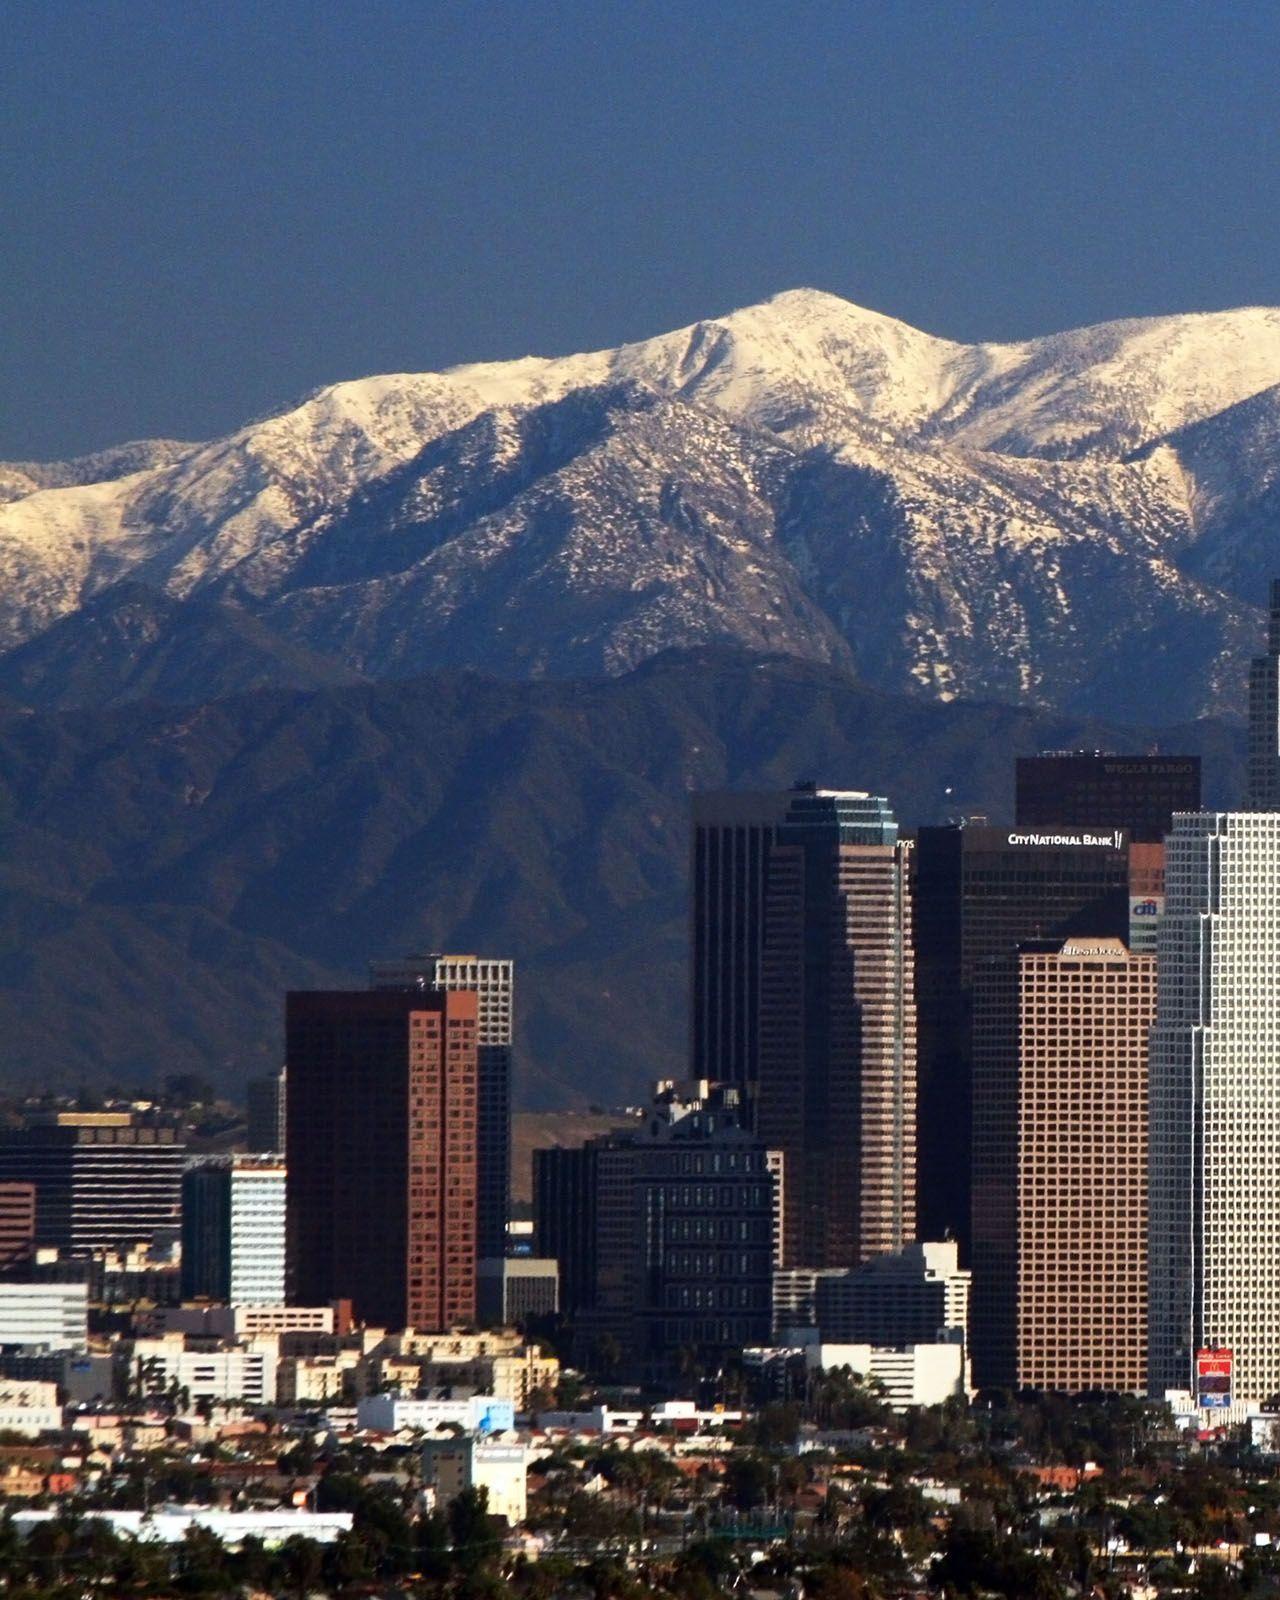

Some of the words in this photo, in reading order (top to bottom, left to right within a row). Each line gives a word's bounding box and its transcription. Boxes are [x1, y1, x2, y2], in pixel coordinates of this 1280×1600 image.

[1151, 763, 1193, 774] FARGO
[1008, 834, 1030, 845] CITY
[1030, 834, 1082, 846] NATIONAL
[1083, 835, 1112, 846] BANK
